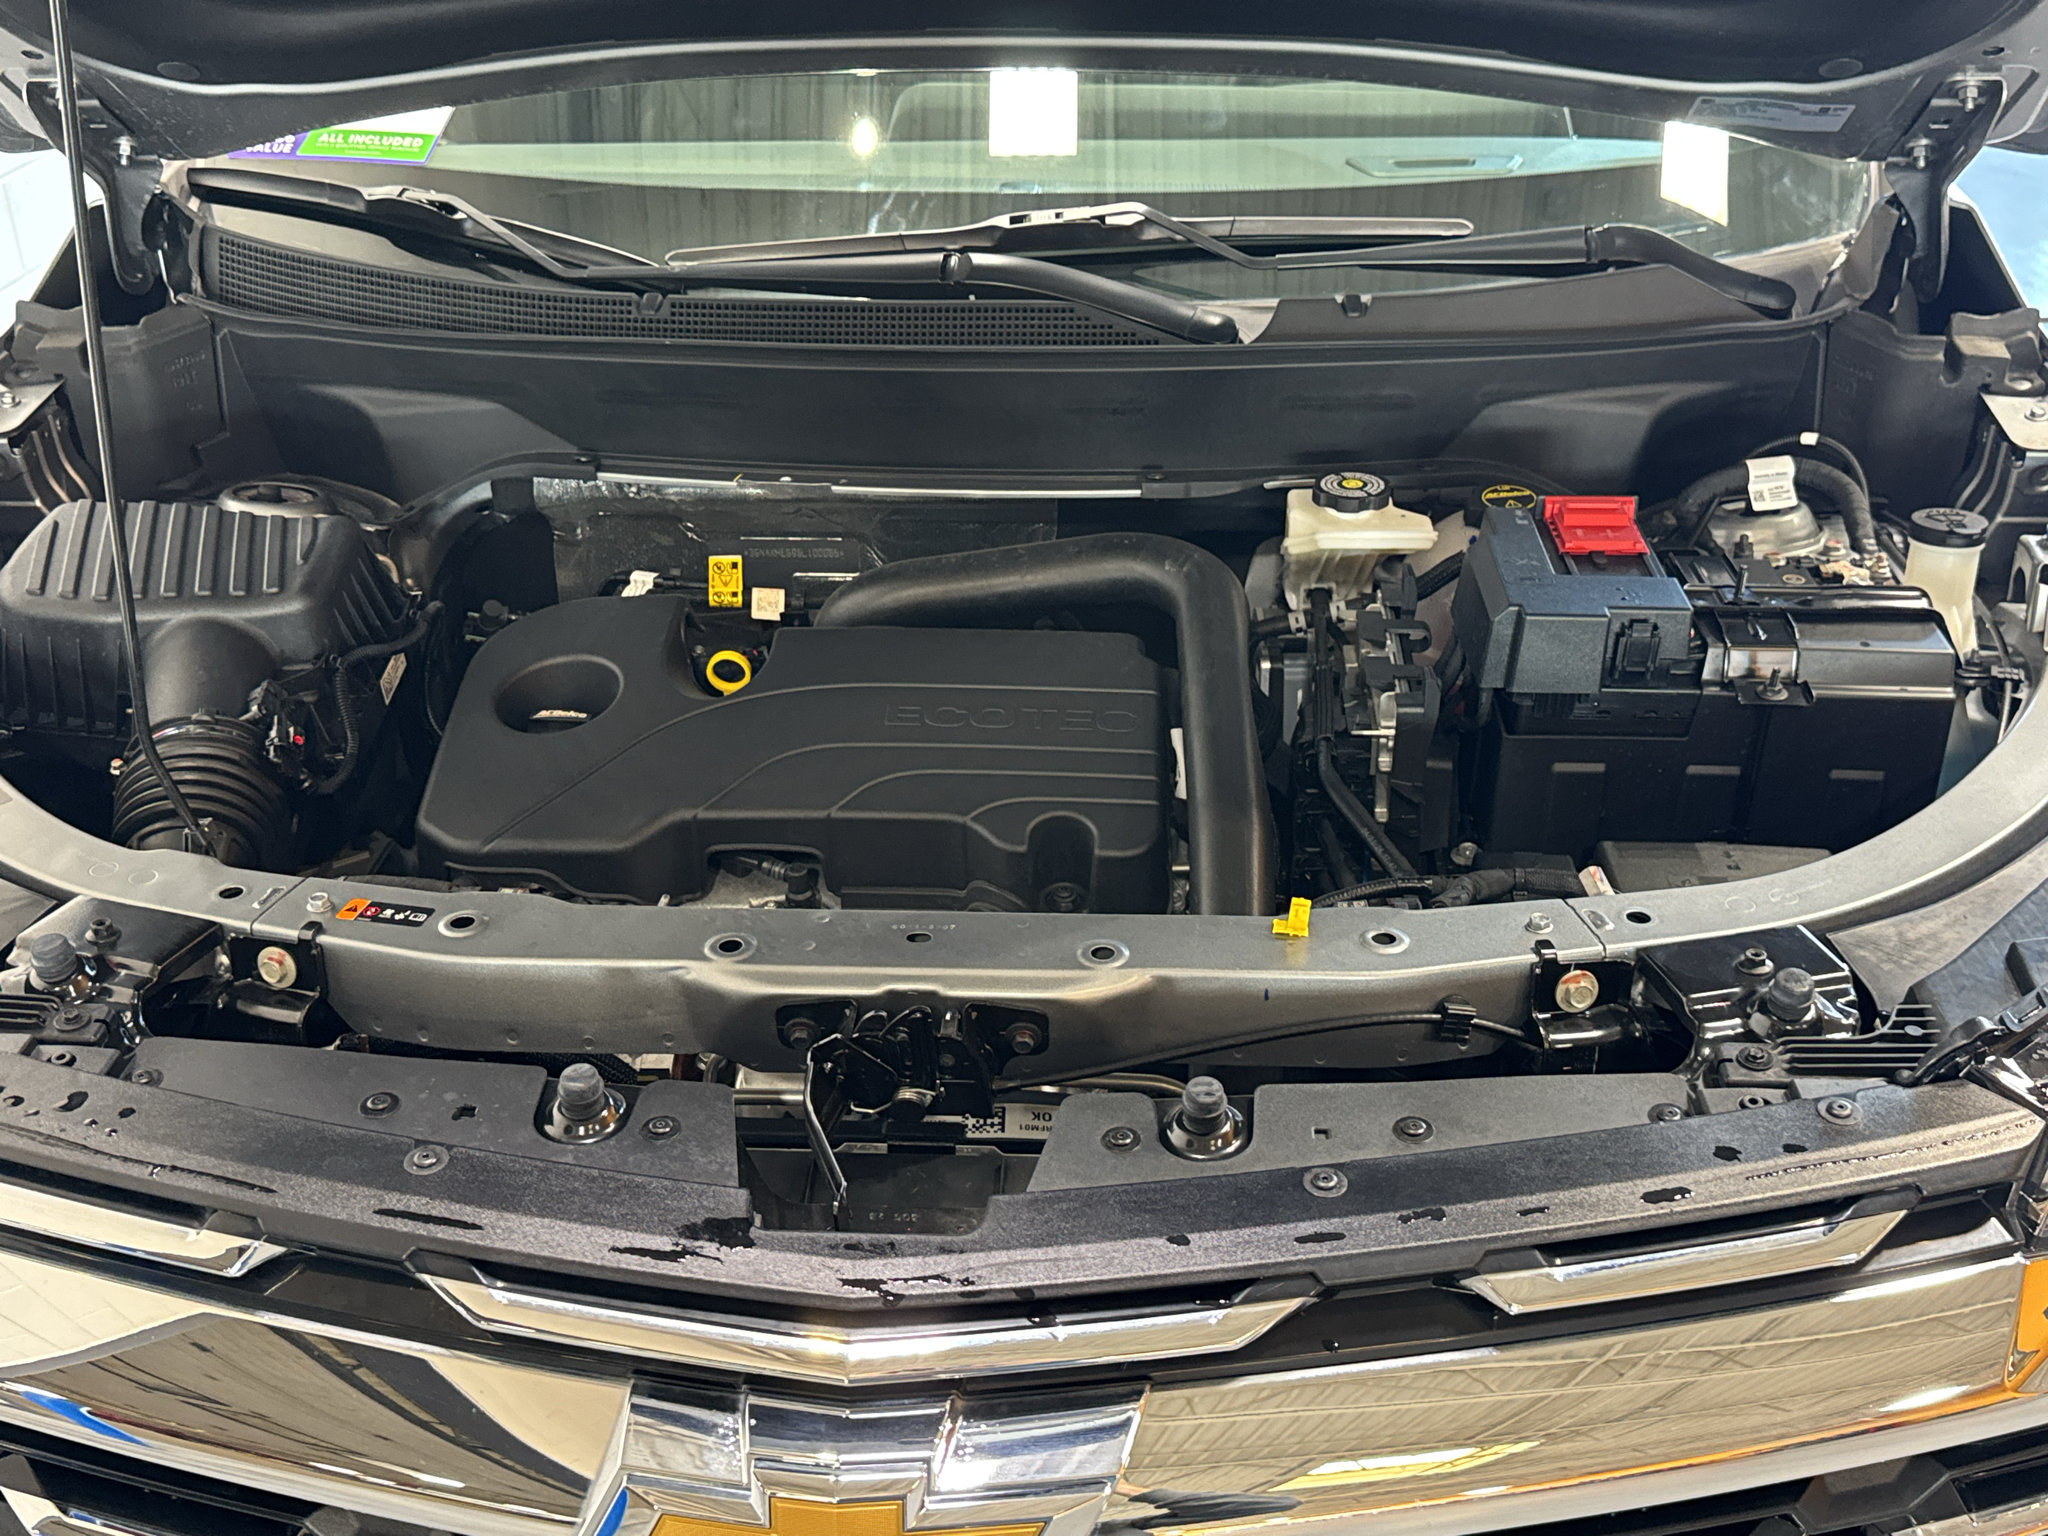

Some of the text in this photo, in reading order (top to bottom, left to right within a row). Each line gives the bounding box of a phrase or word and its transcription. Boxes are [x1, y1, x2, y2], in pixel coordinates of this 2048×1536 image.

[318, 133, 345, 144] ALL
[348, 134, 424, 148] INCLUDED
[884, 705, 1139, 733] ECOTEC
[1031, 1111, 1053, 1122] OK
